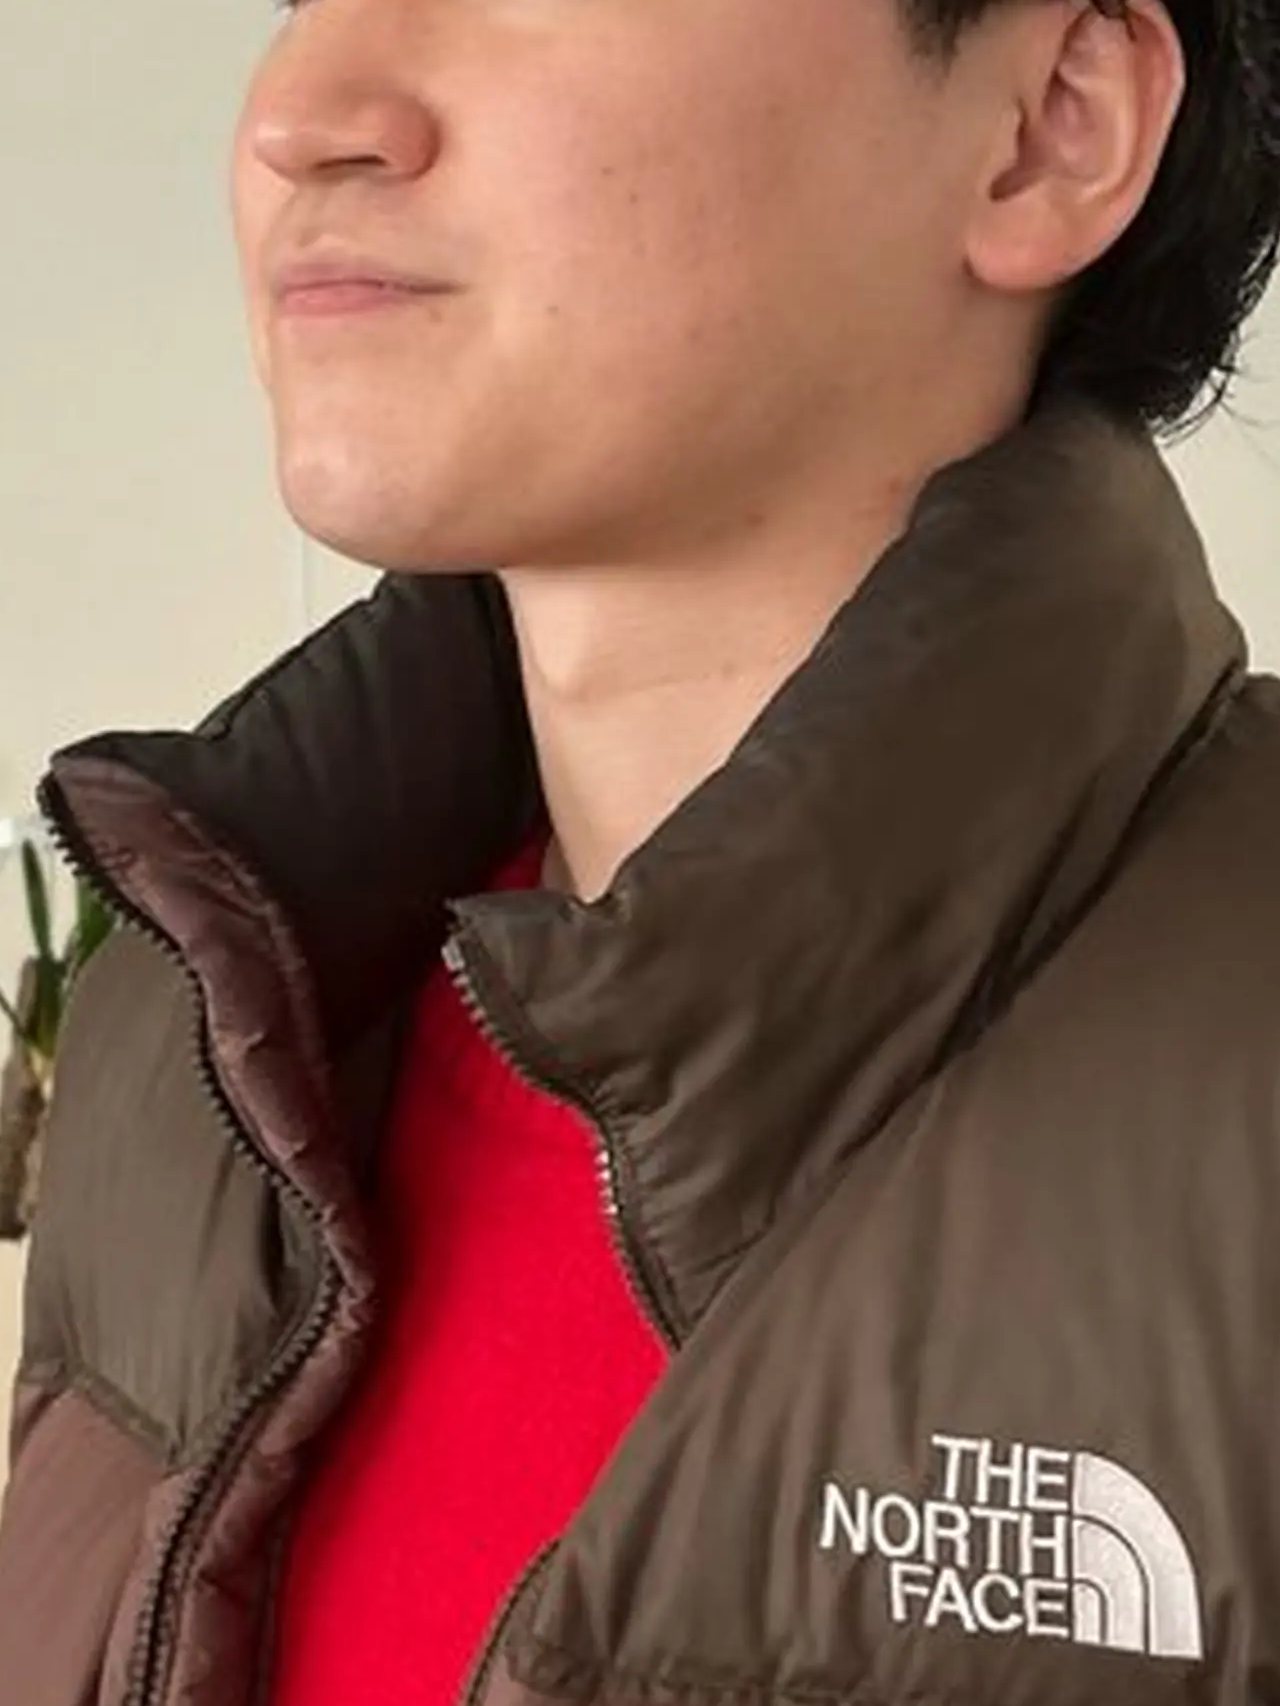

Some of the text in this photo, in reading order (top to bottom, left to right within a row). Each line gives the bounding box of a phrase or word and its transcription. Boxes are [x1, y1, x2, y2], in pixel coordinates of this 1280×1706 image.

[931, 1433, 1070, 1510] THE
[820, 1483, 1067, 1579] NORTH
[890, 1560, 1070, 1637] FACE
